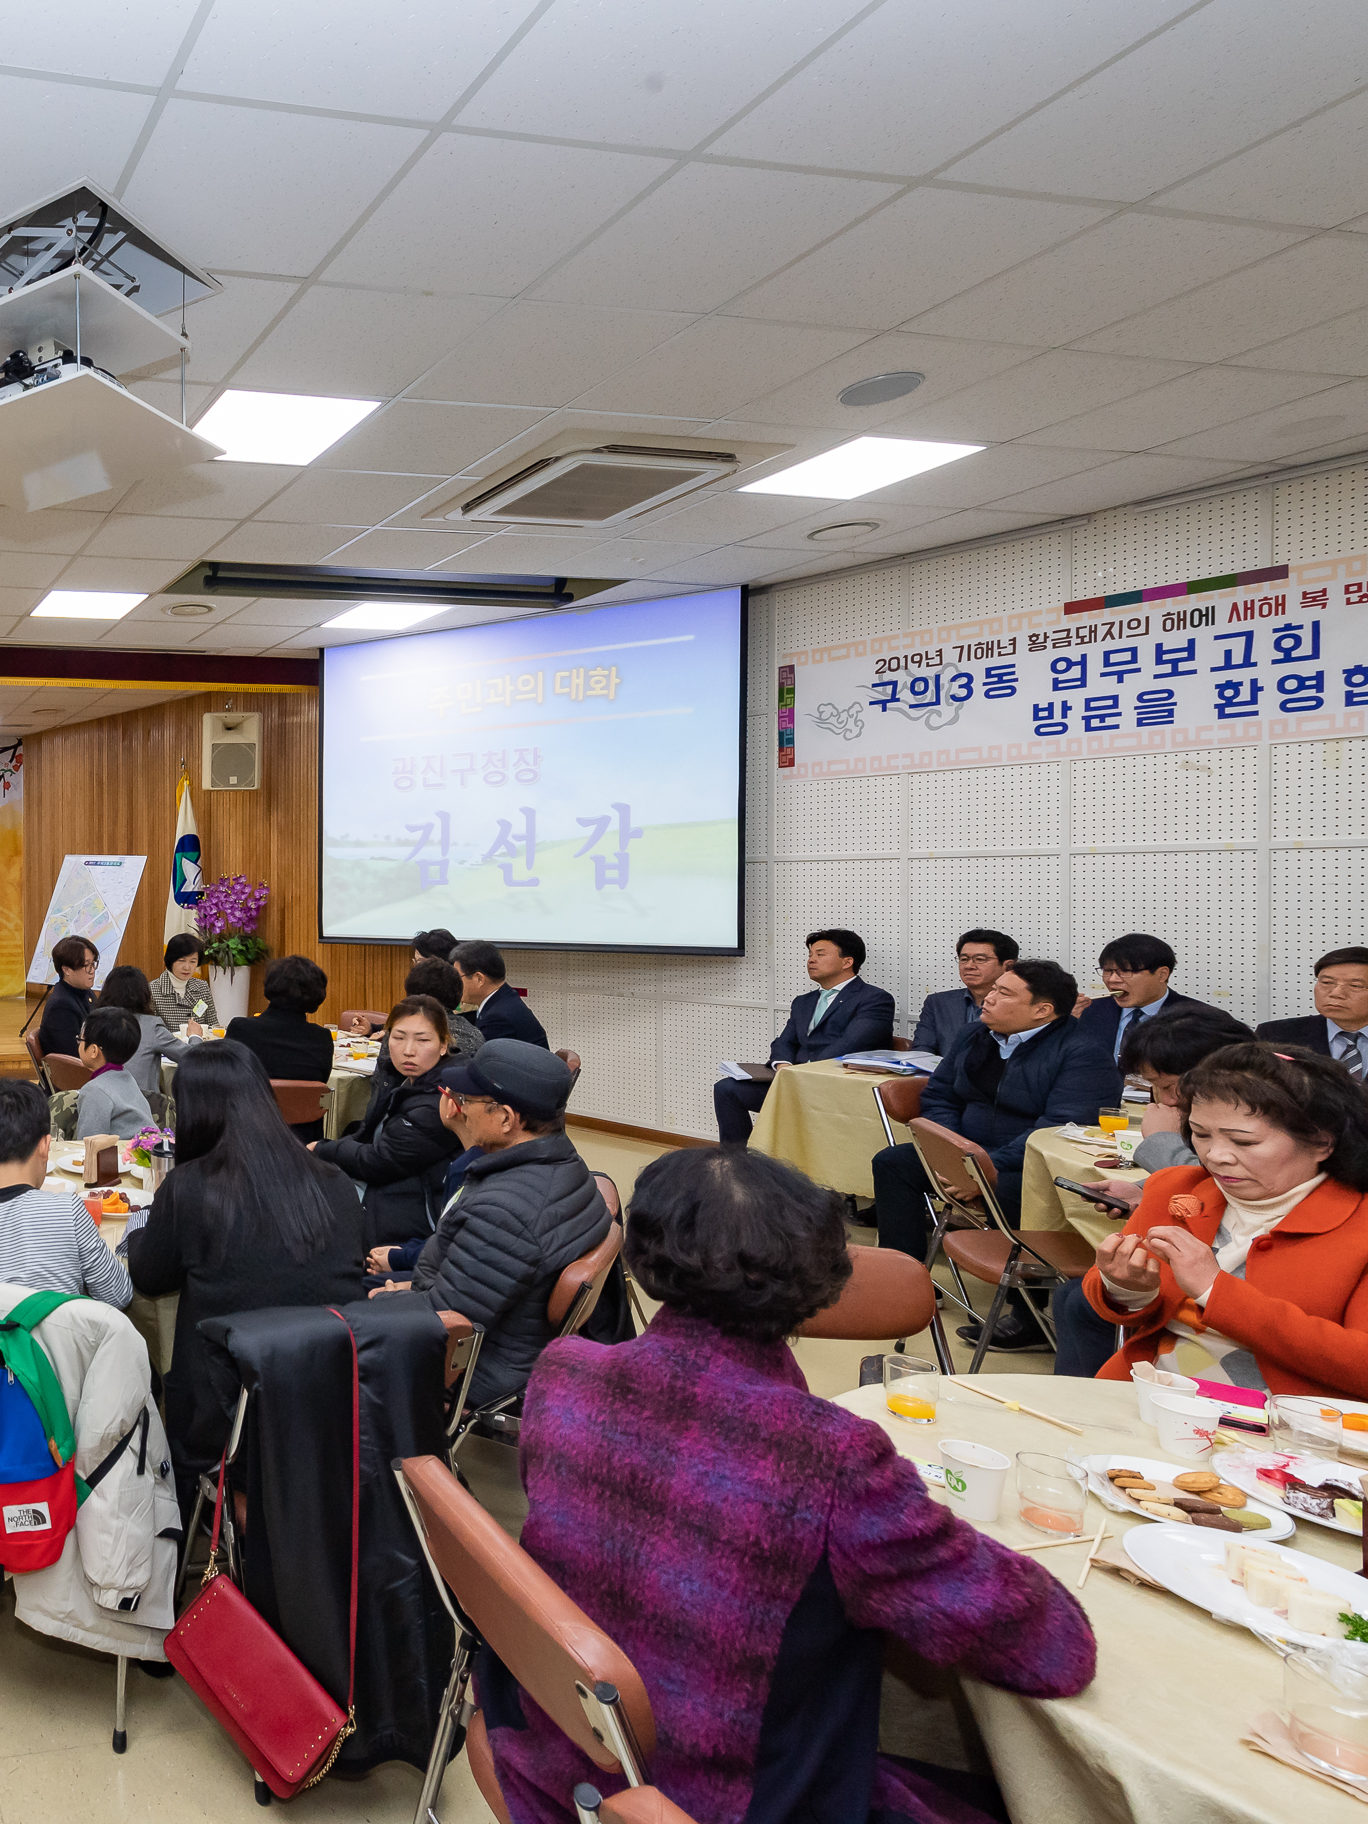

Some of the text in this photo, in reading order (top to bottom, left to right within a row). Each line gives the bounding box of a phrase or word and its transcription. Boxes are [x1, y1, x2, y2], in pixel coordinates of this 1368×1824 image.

[875, 648, 943, 675] 2019년
[952, 637, 1017, 663] 기해년
[1027, 616, 1150, 653] 황금돼지의
[1162, 605, 1216, 632] 해에
[1228, 594, 1287, 623] 새해
[1300, 588, 1329, 610] 복
[869, 620, 1321, 712] 구의3동 업무보고회
[428, 666, 621, 719] 주민과의 대화
[1033, 689, 1178, 736] 방문을
[391, 747, 543, 791] 광진구청장
[8, 1514, 33, 1523] NORTH
[15, 1520, 34, 1528] FACE
